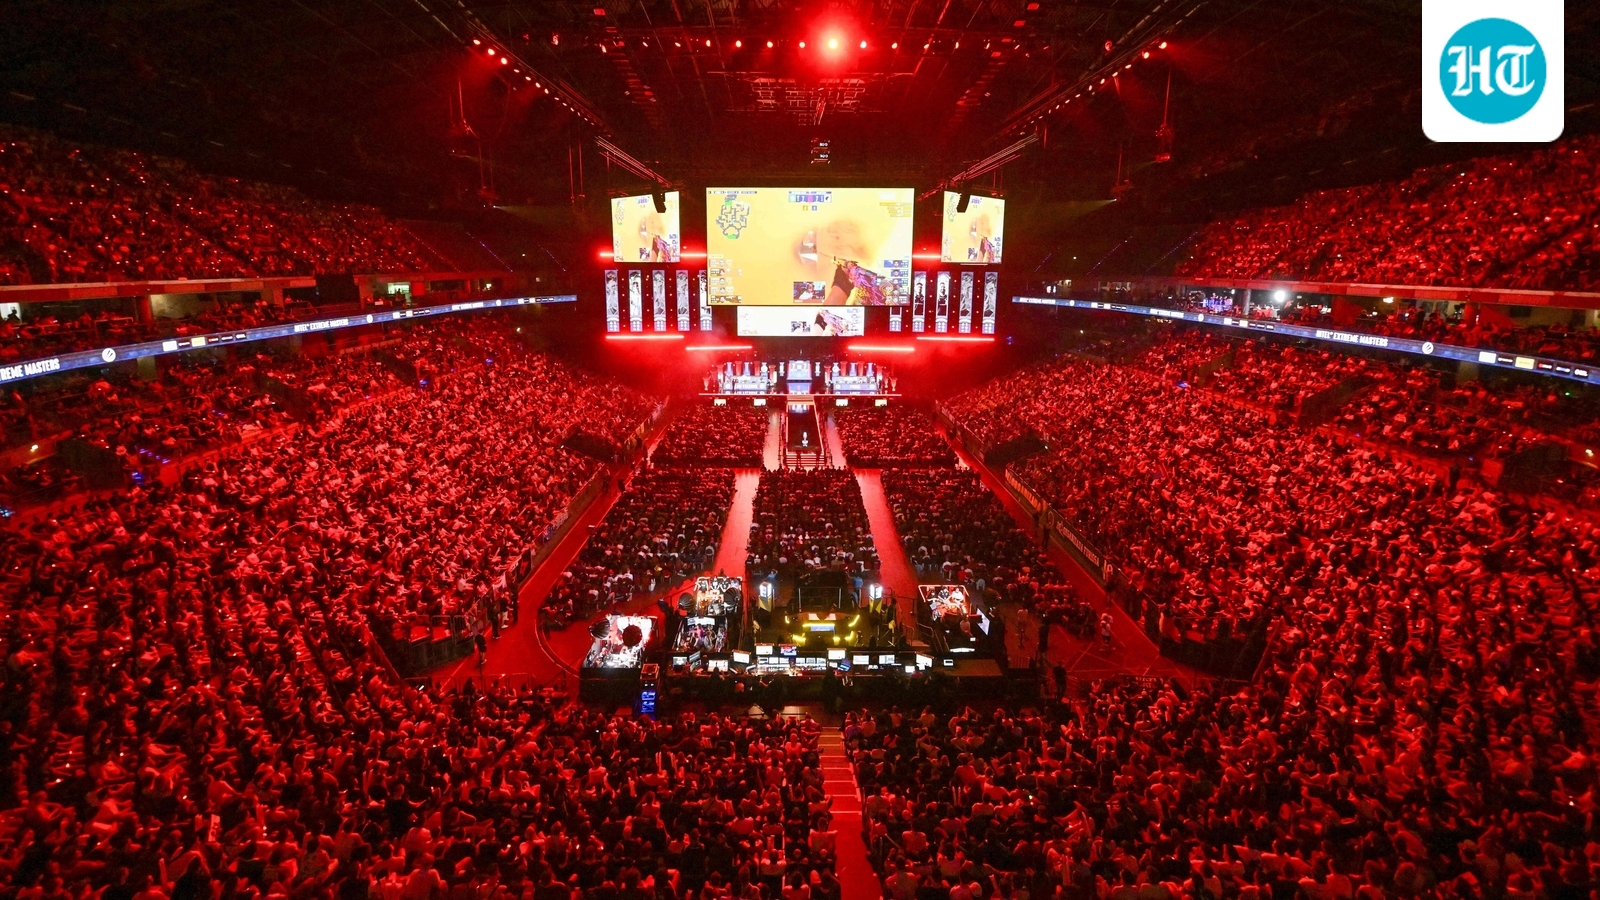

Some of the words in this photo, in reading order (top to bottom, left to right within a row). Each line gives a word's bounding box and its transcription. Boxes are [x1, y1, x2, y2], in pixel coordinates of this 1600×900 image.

[1333, 332, 1359, 343] EXTREME
[1359, 335, 1388, 347] MASTERS
[0, 364, 24, 381] REME
[24, 358, 60, 375] MASTERS
